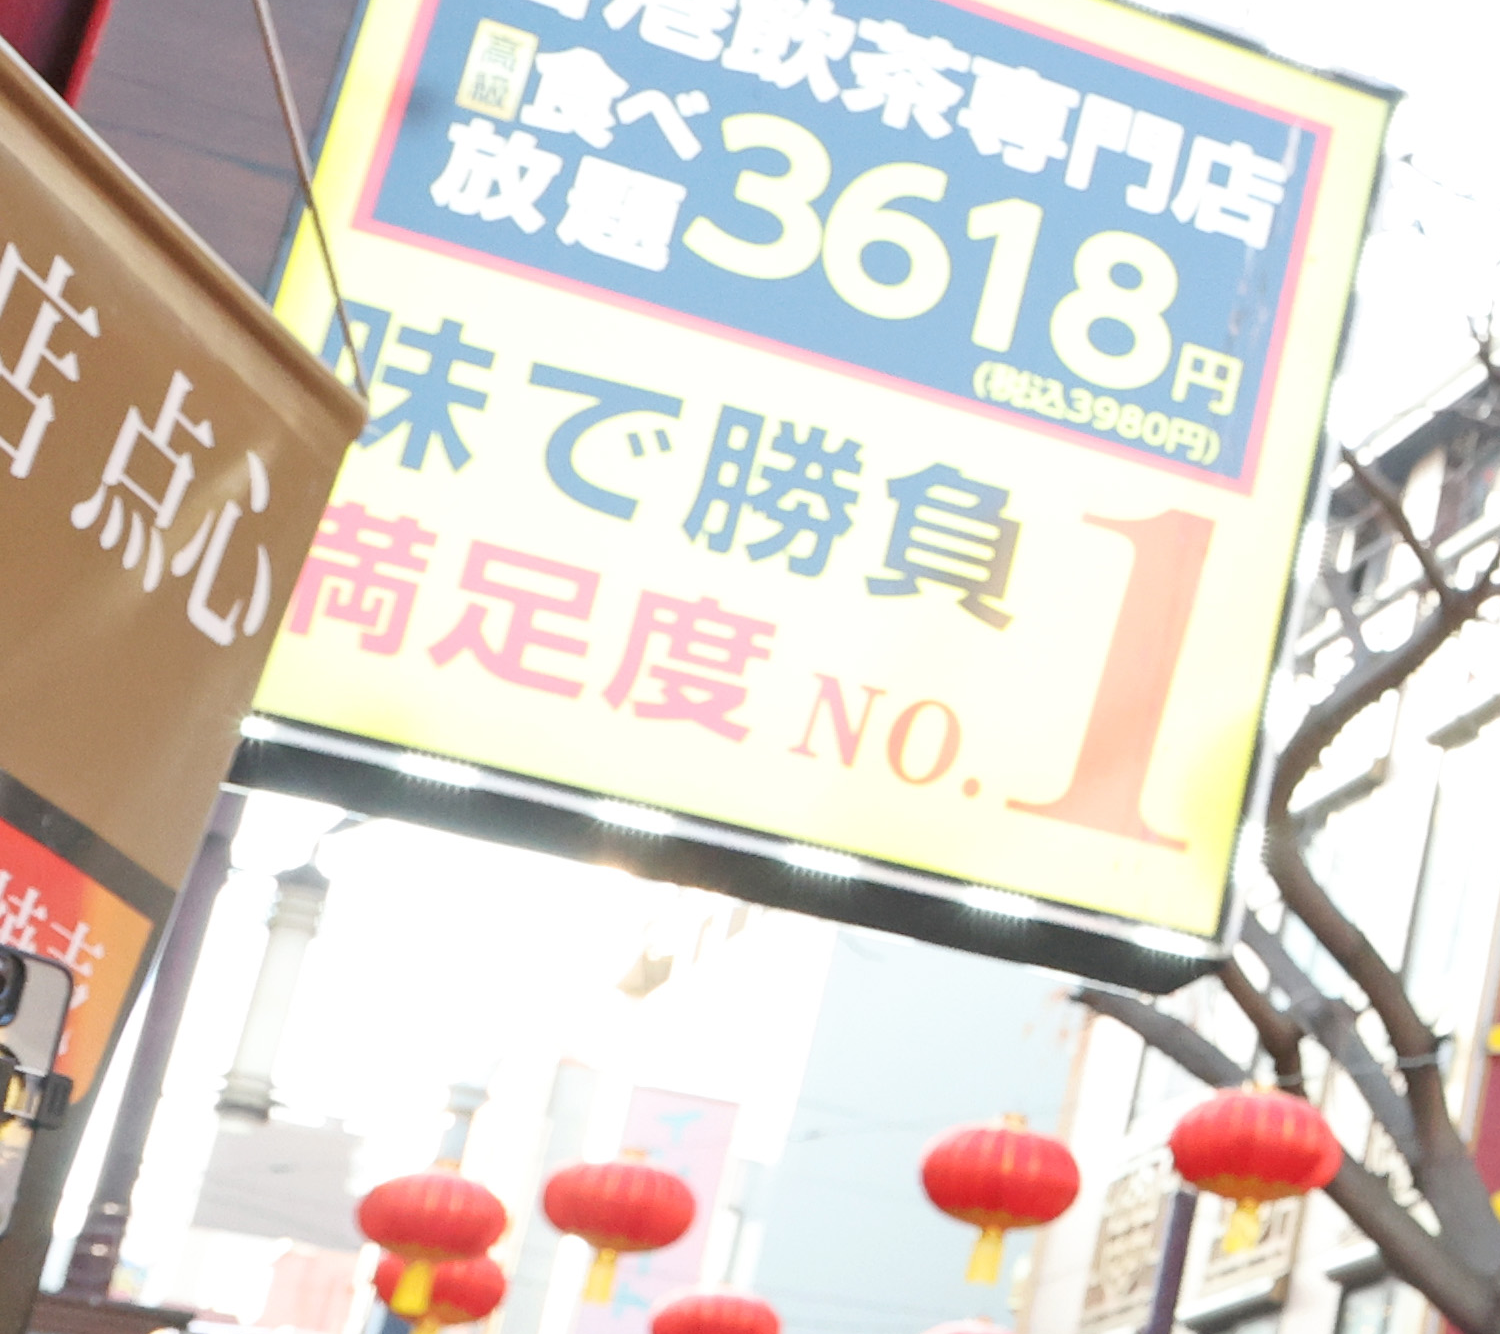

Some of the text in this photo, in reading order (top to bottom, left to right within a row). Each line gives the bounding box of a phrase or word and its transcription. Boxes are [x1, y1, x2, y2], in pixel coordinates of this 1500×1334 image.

[430, 117, 687, 273] 放題
[520, 46, 711, 161] 食べ
[318, 301, 1022, 631] 味で勝負
[287, 501, 778, 744] 満足度
